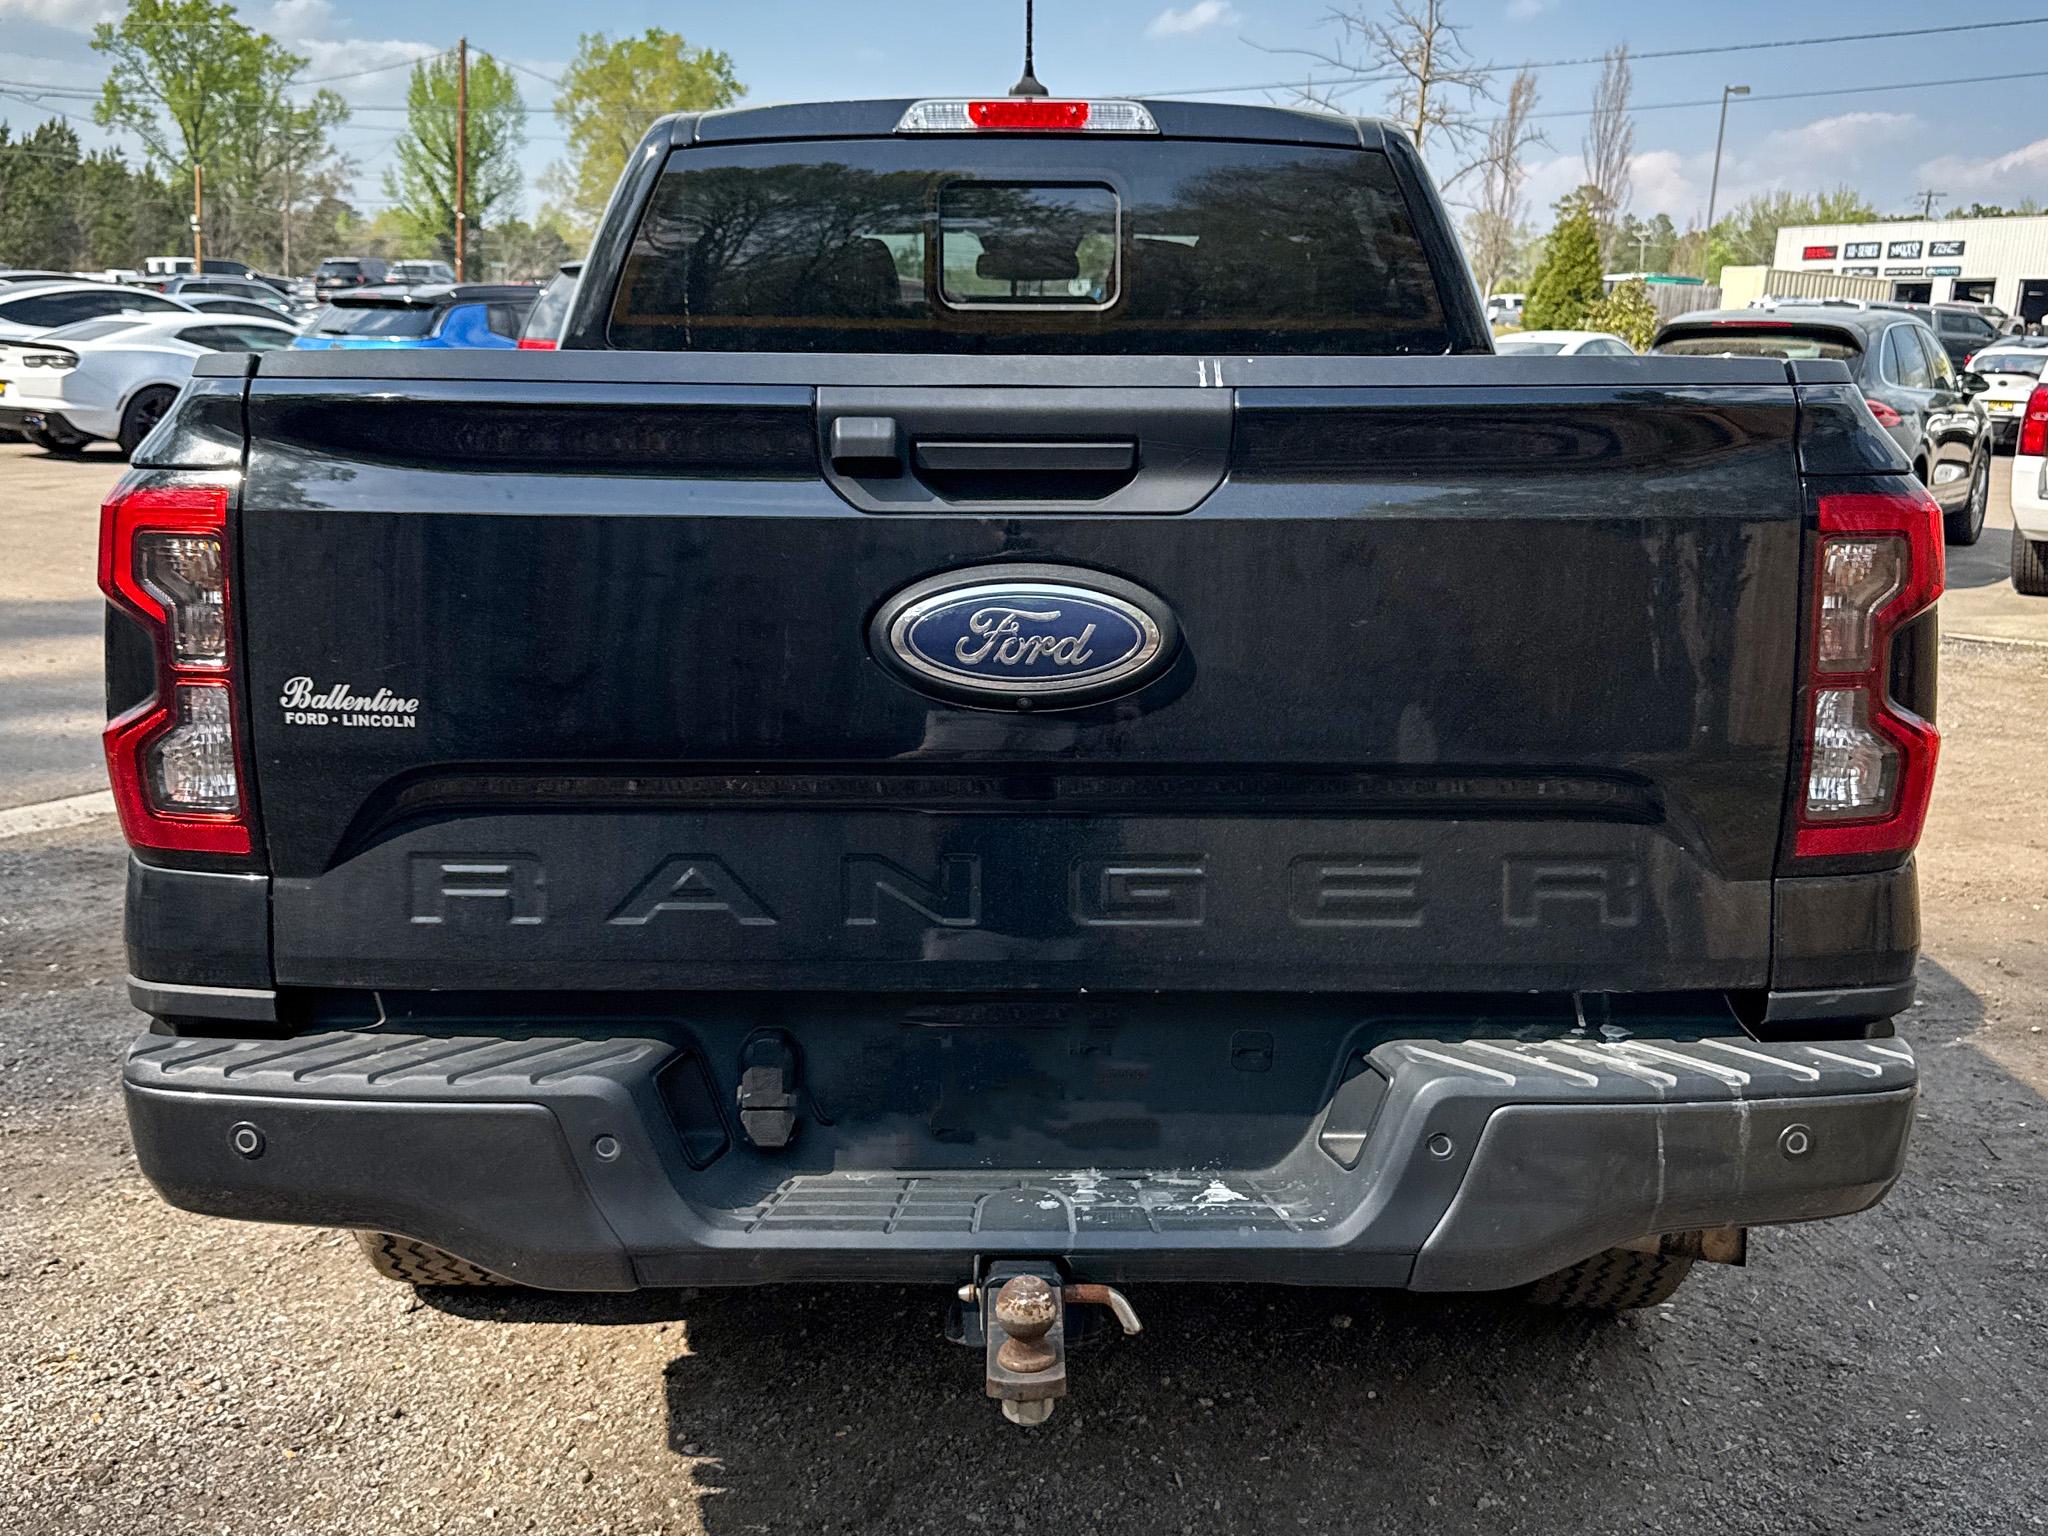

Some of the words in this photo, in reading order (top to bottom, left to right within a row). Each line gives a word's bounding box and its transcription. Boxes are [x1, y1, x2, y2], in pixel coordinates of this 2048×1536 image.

[955, 606, 1096, 666] Ford
[279, 676, 420, 713] Ballentine
[285, 711, 329, 726] FORD
[342, 713, 416, 728] LINCOLN
[407, 851, 1641, 929] RANGER
